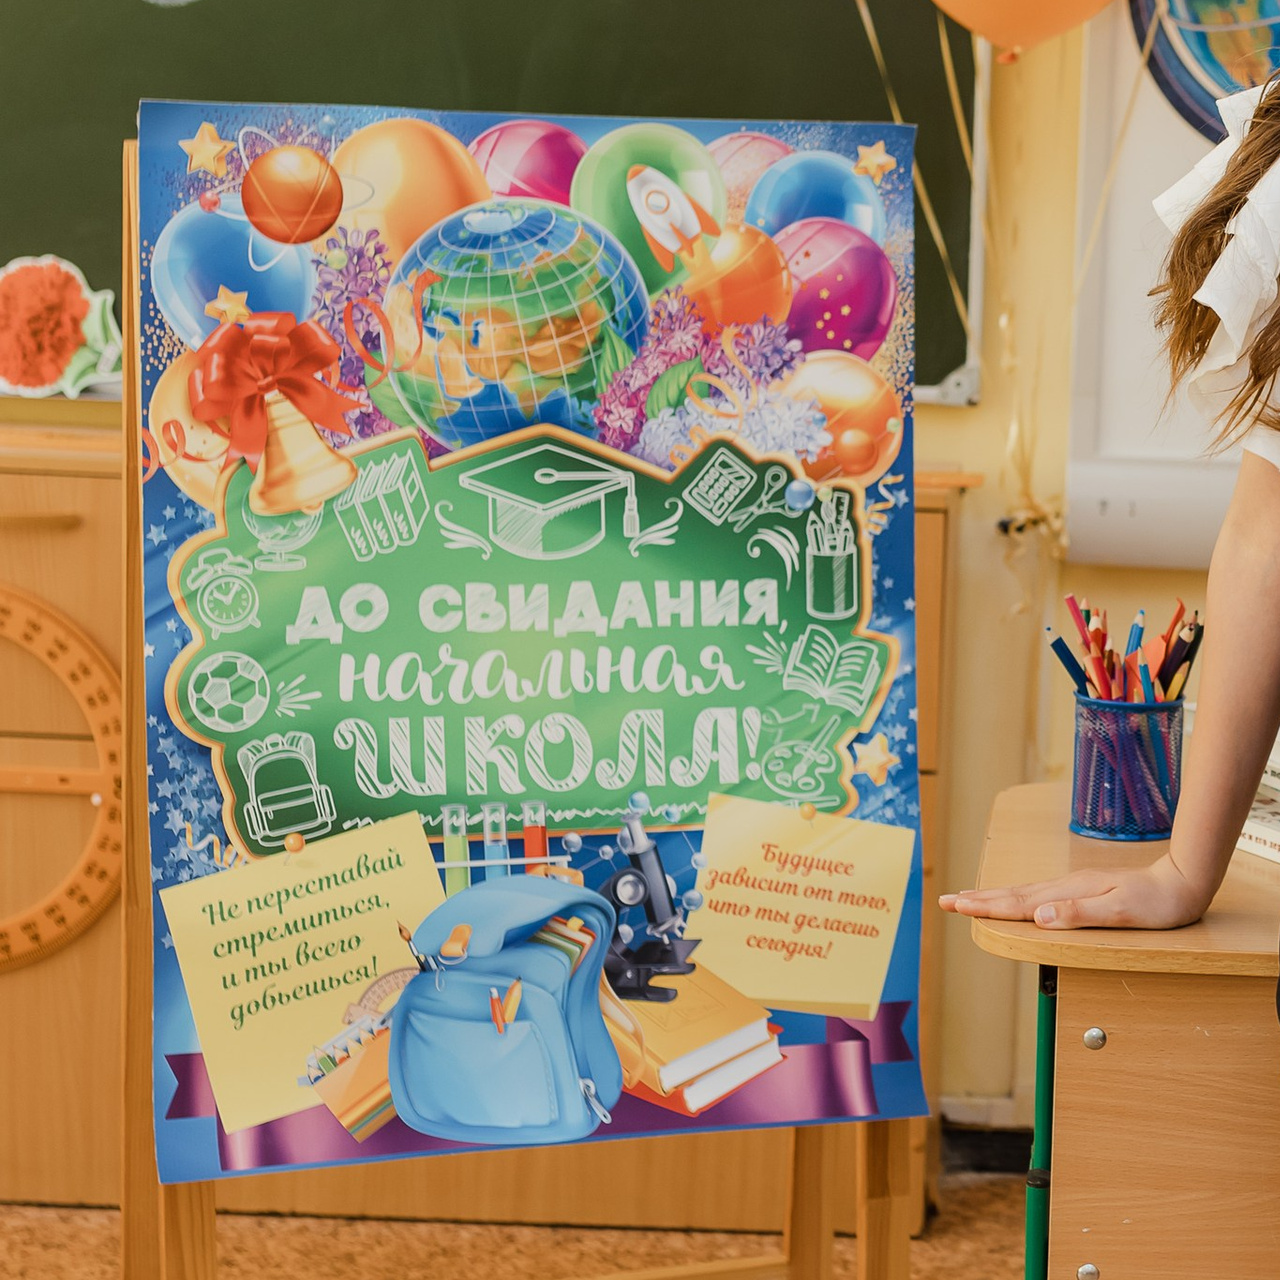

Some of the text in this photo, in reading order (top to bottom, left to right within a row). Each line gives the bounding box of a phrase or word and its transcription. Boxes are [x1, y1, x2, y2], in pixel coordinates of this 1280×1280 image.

[286, 578, 788, 645] ДО СВИДАНИЯ,
[339, 643, 745, 705] начальная
[333, 705, 763, 799] ШКОЛА!
[202, 847, 405, 925] Не переставай
[705, 867, 799, 897] зависит
[803, 885, 834, 902] от
[762, 843, 855, 877] Будущее
[213, 892, 390, 958] стремиться,
[708, 897, 880, 939] что ты делаешь
[746, 934, 834, 962] сегодня!
[222, 933, 363, 990] и ты всего
[230, 956, 379, 1030] добьешься!
